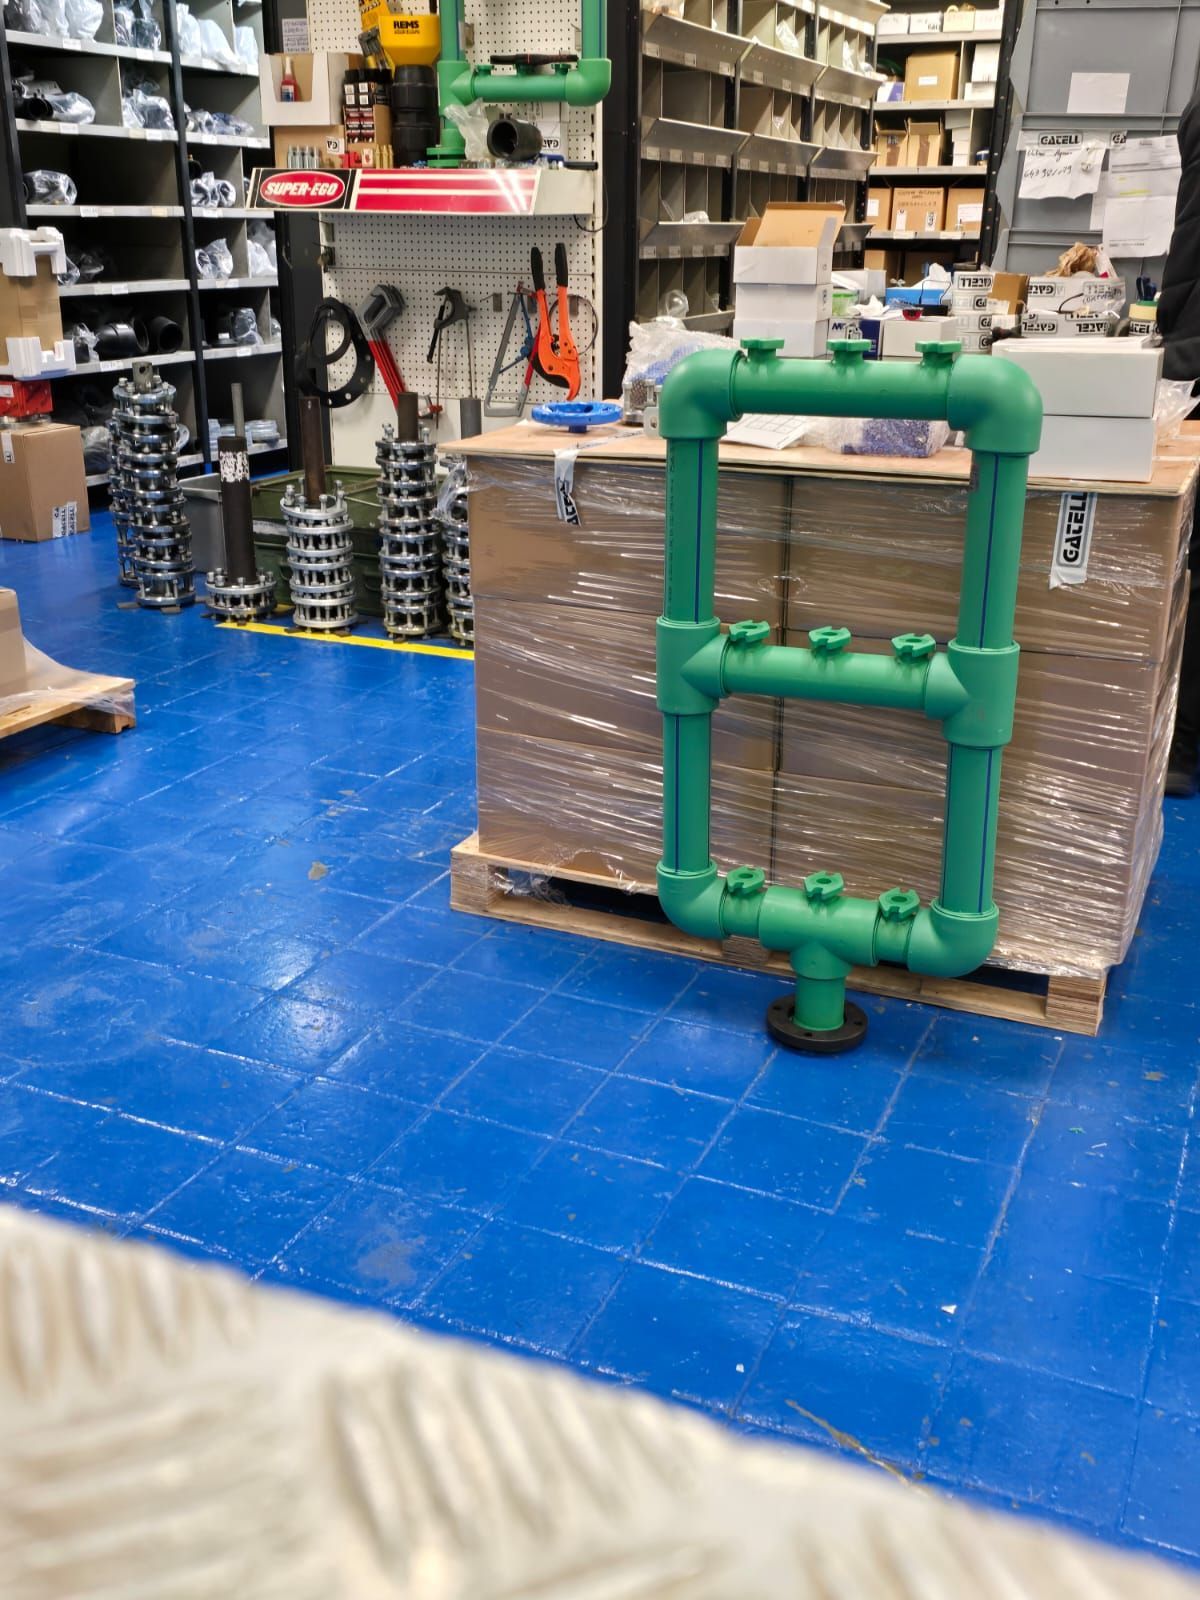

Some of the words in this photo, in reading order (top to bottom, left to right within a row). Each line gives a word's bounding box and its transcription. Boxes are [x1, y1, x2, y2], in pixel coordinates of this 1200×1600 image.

[393, 20, 419, 29] REMS
[1041, 135, 1080, 145] GATELL
[264, 182, 339, 196] SUPER-EGO
[1062, 492, 1088, 563] GATELL
